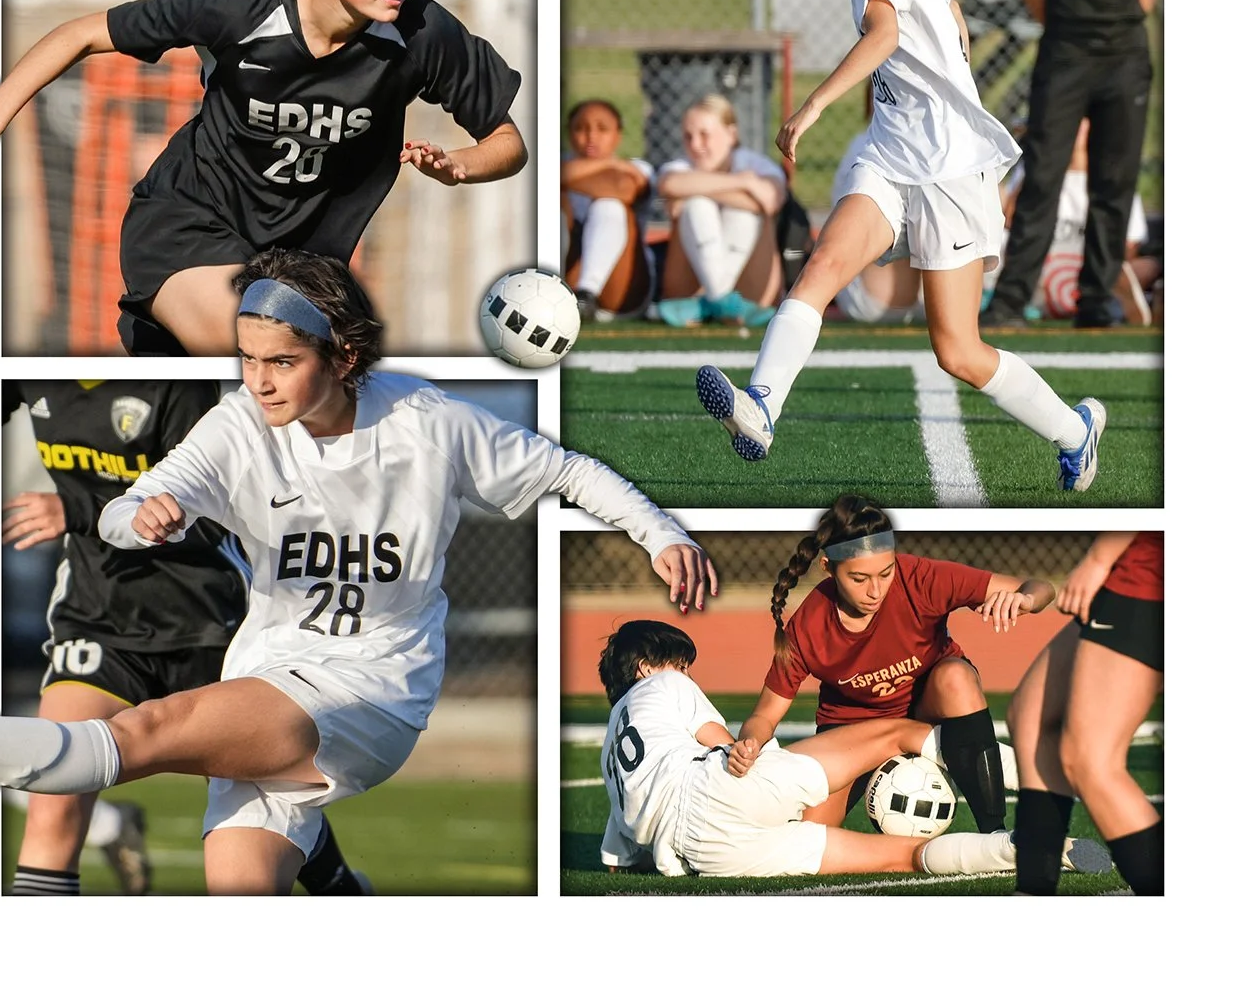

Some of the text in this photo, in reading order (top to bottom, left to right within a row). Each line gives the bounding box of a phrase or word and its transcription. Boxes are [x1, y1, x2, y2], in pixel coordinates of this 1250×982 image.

[248, 97, 373, 144] EDHS
[36, 440, 153, 482] OOTHILL
[276, 530, 403, 584] EDHS
[298, 581, 366, 637] 28
[850, 655, 923, 689] ESPERANZA
